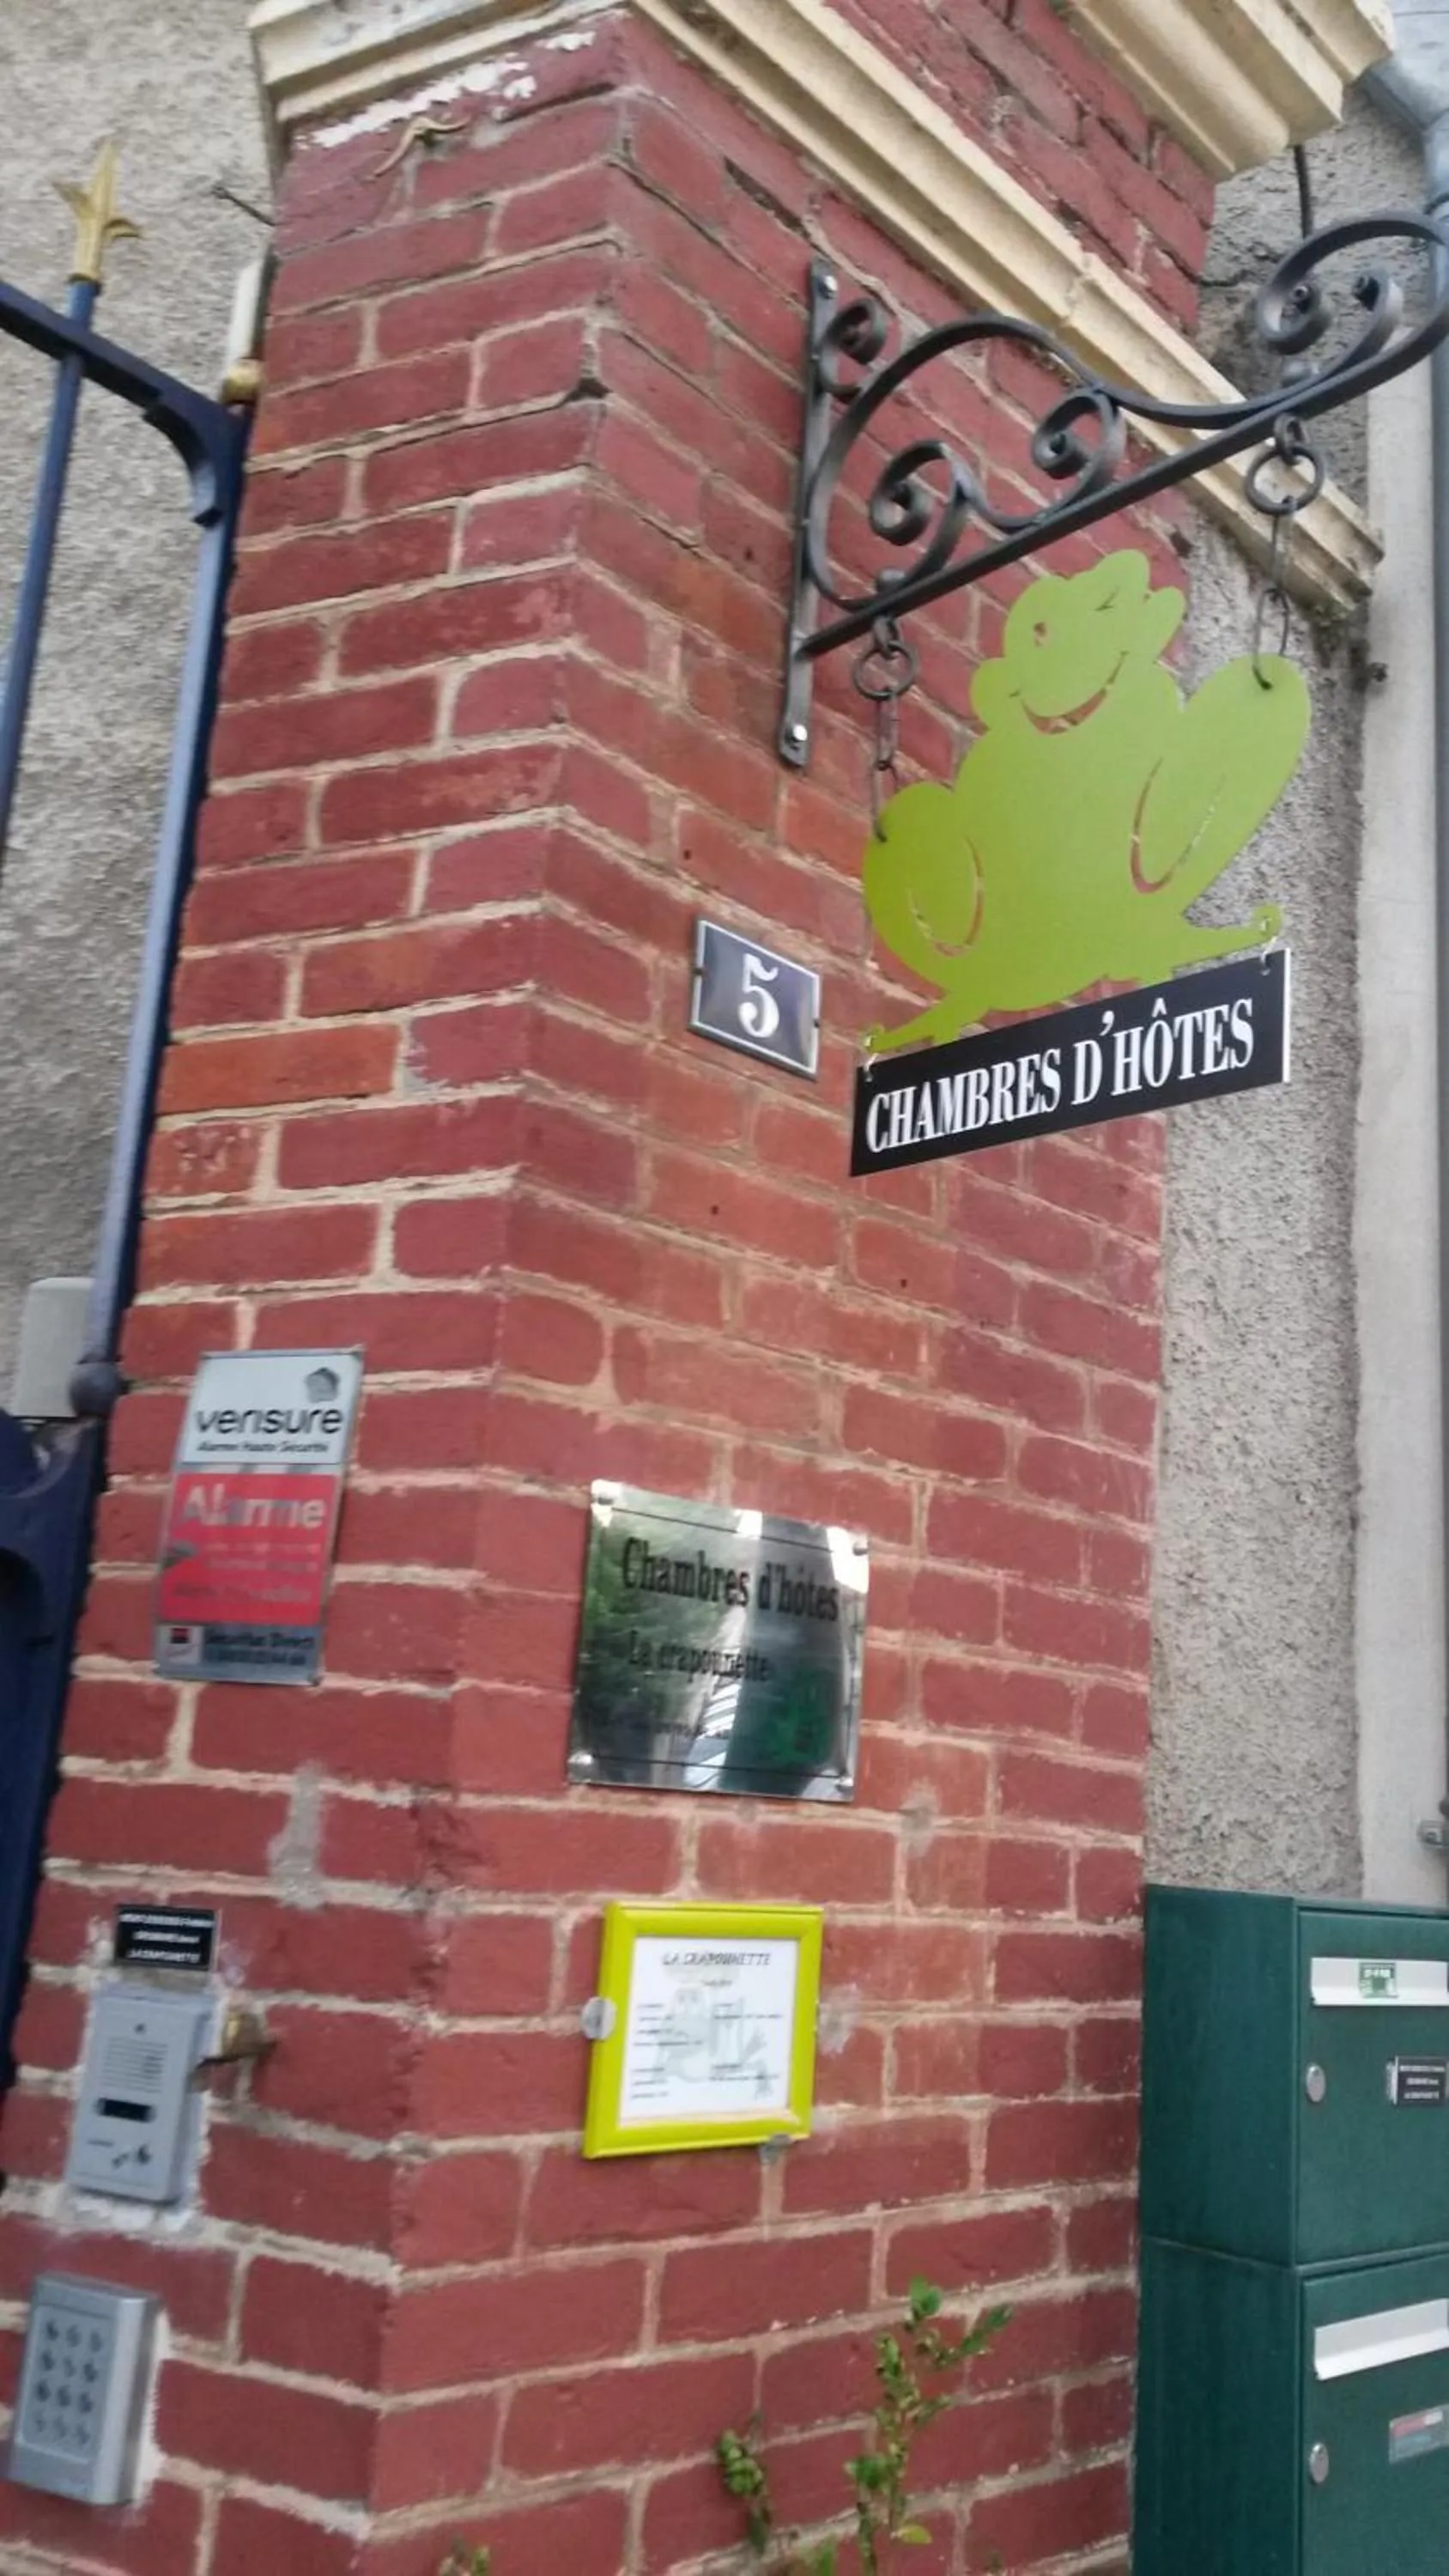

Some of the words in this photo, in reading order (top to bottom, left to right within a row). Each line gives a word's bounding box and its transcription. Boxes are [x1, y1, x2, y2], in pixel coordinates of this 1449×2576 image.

[738, 953, 779, 1037] 5
[865, 1048, 1062, 1153] CHAMBRES
[1071, 997, 1254, 1106] D'HÔTES
[183, 1484, 325, 1529] Alarme
[622, 1536, 749, 1607] Chambres
[627, 1630, 651, 1667] La
